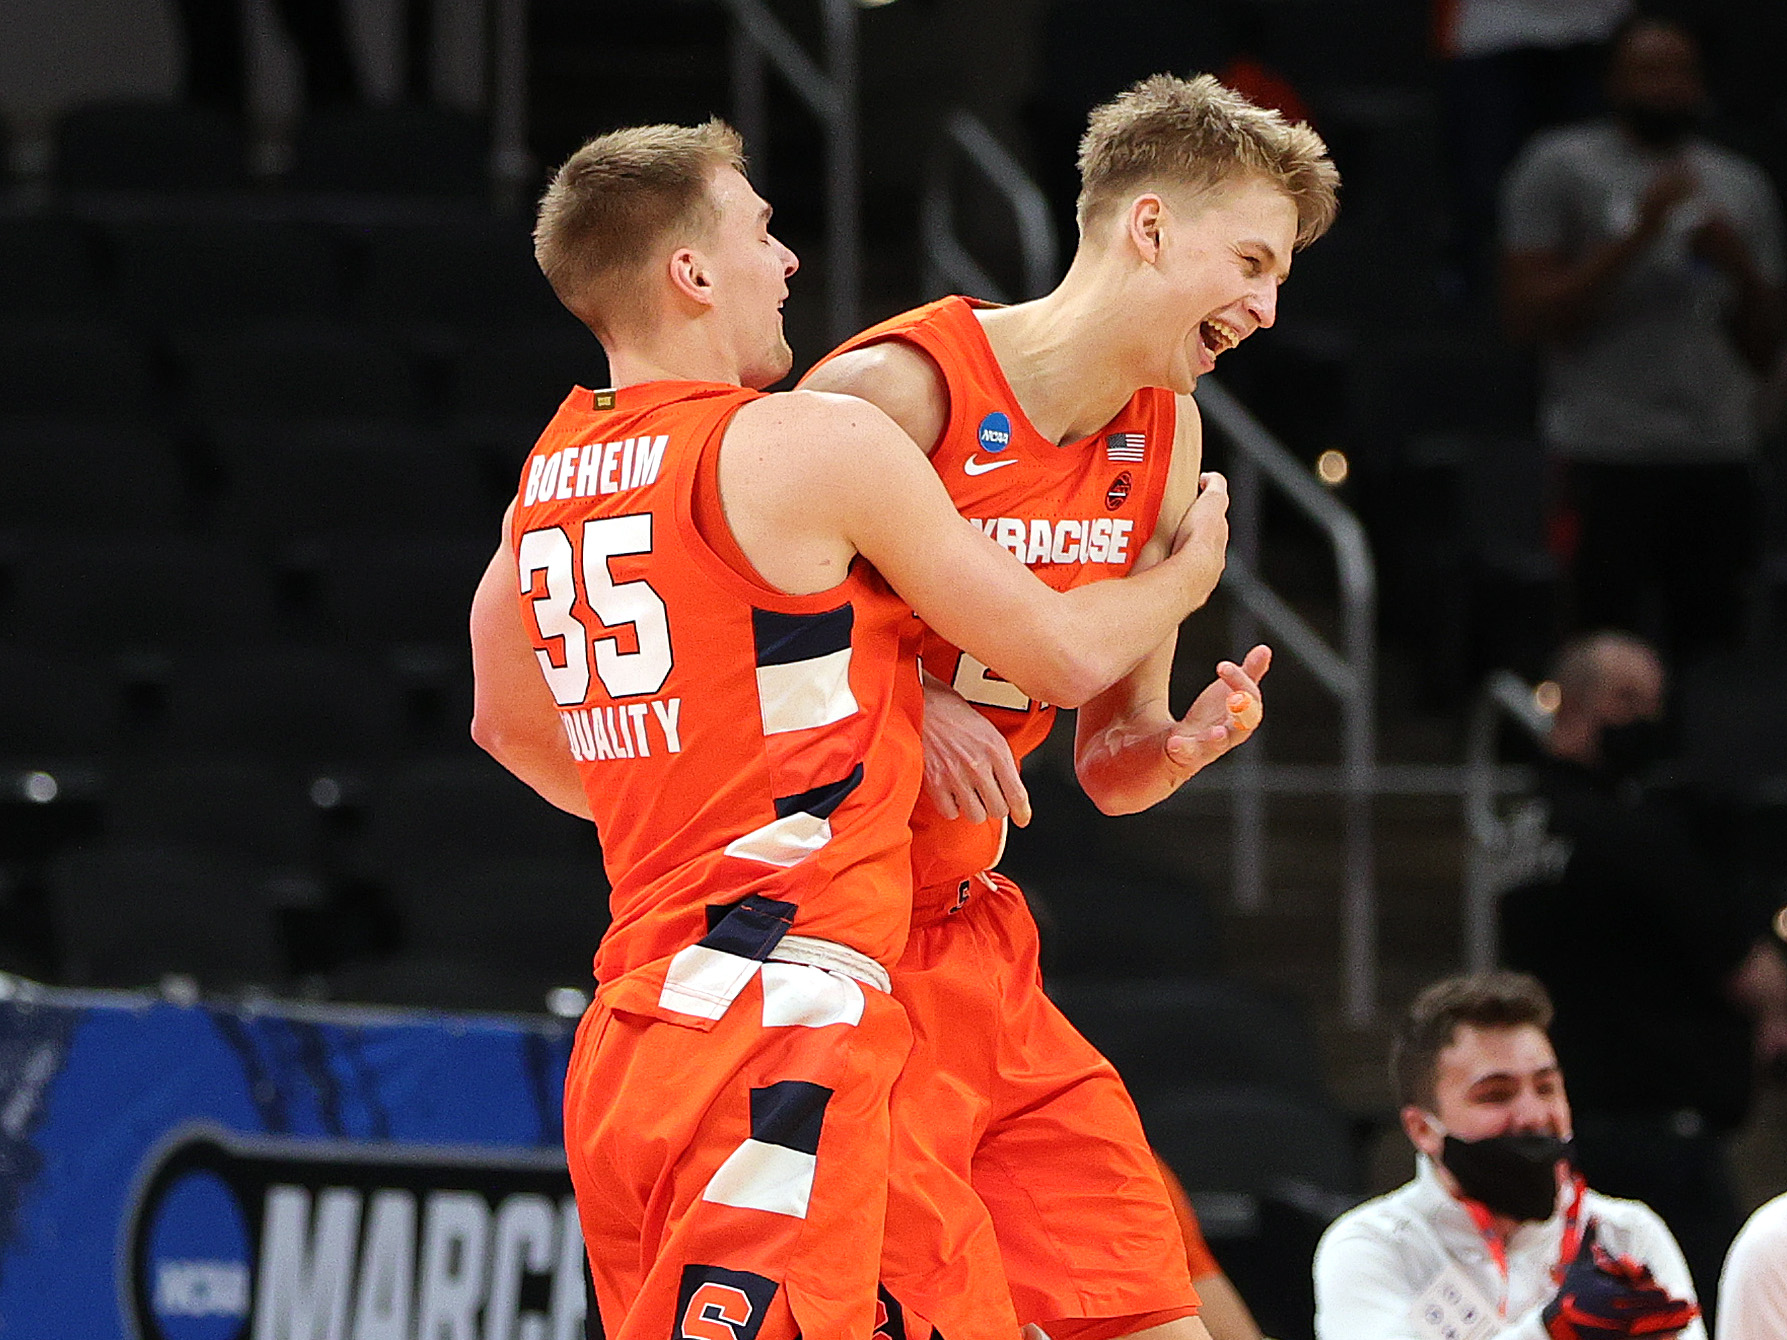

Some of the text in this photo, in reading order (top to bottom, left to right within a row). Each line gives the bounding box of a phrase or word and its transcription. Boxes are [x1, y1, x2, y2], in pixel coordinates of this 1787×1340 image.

[981, 429, 1009, 445] NCAA
[524, 435, 669, 507] BOEHEIM
[970, 517, 1133, 564] YRACUSE
[518, 512, 674, 706] 35
[559, 698, 681, 761] QUALITY
